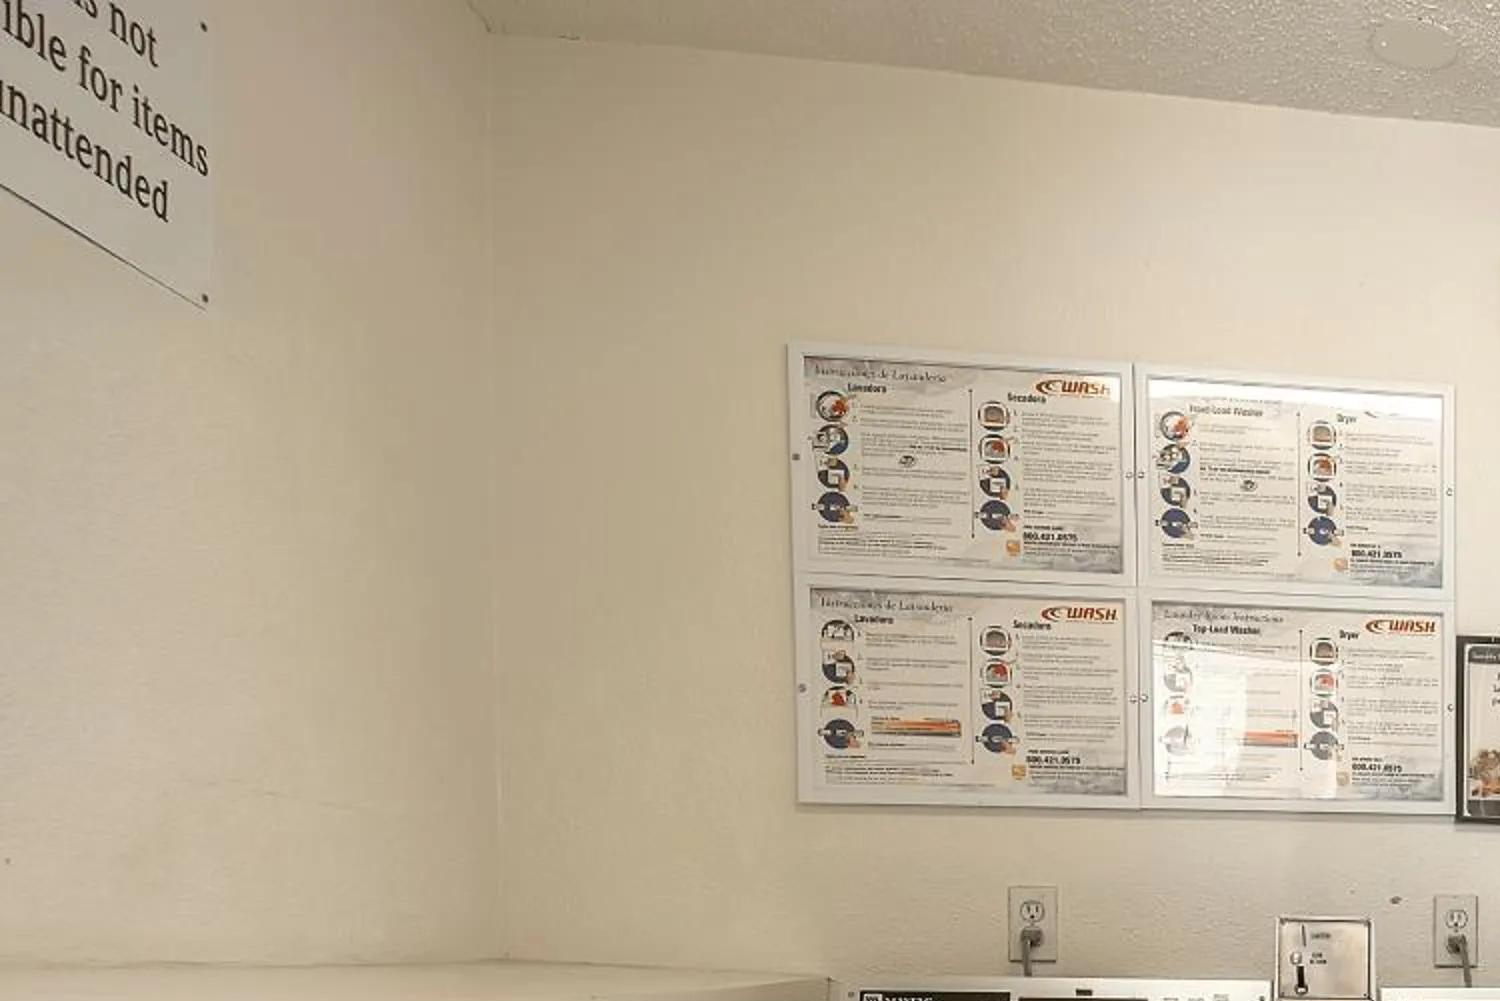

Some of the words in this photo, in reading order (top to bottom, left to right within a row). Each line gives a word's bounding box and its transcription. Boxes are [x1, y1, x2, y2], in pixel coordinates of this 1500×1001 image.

[109, 1, 159, 68] not
[78, 44, 123, 112] for
[132, 84, 208, 176] items
